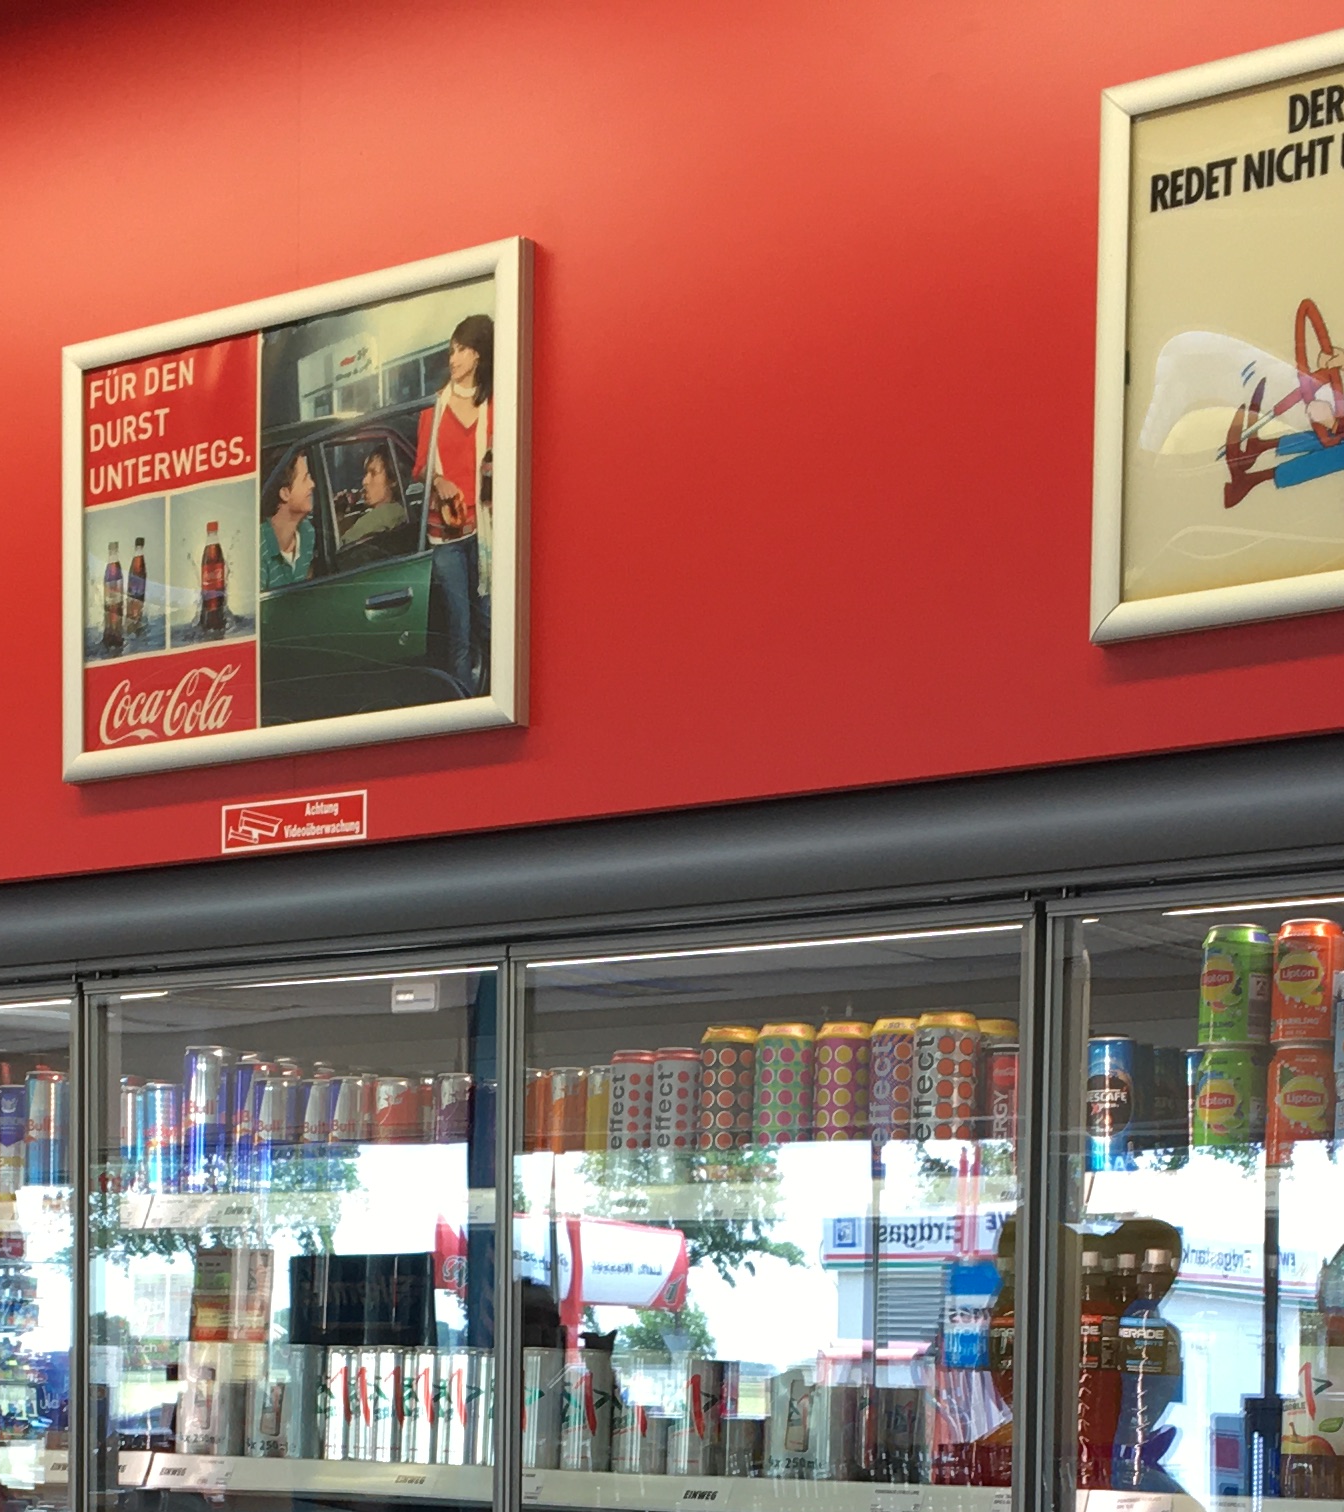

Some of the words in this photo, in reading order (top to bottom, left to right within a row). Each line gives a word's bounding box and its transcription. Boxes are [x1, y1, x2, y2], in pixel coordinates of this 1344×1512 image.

[1288, 86, 1344, 133] DER
[1150, 158, 1236, 213] REDET
[1242, 136, 1330, 193] NICHT
[89, 369, 136, 409] FÜR
[143, 357, 194, 394] DEN
[89, 408, 170, 453] DURST
[89, 437, 251, 494] UNTERWEGS.
[283, 819, 360, 838] Videoüberwachung
[305, 803, 339, 817] Achtung
[1282, 968, 1315, 981] Lipton
[610, 1073, 625, 1150] effect
[657, 1070, 674, 1149] effect
[916, 1033, 934, 1143] effect
[1286, 1093, 1321, 1105] Lipton
[683, 1490, 717, 1500] EINWEG
